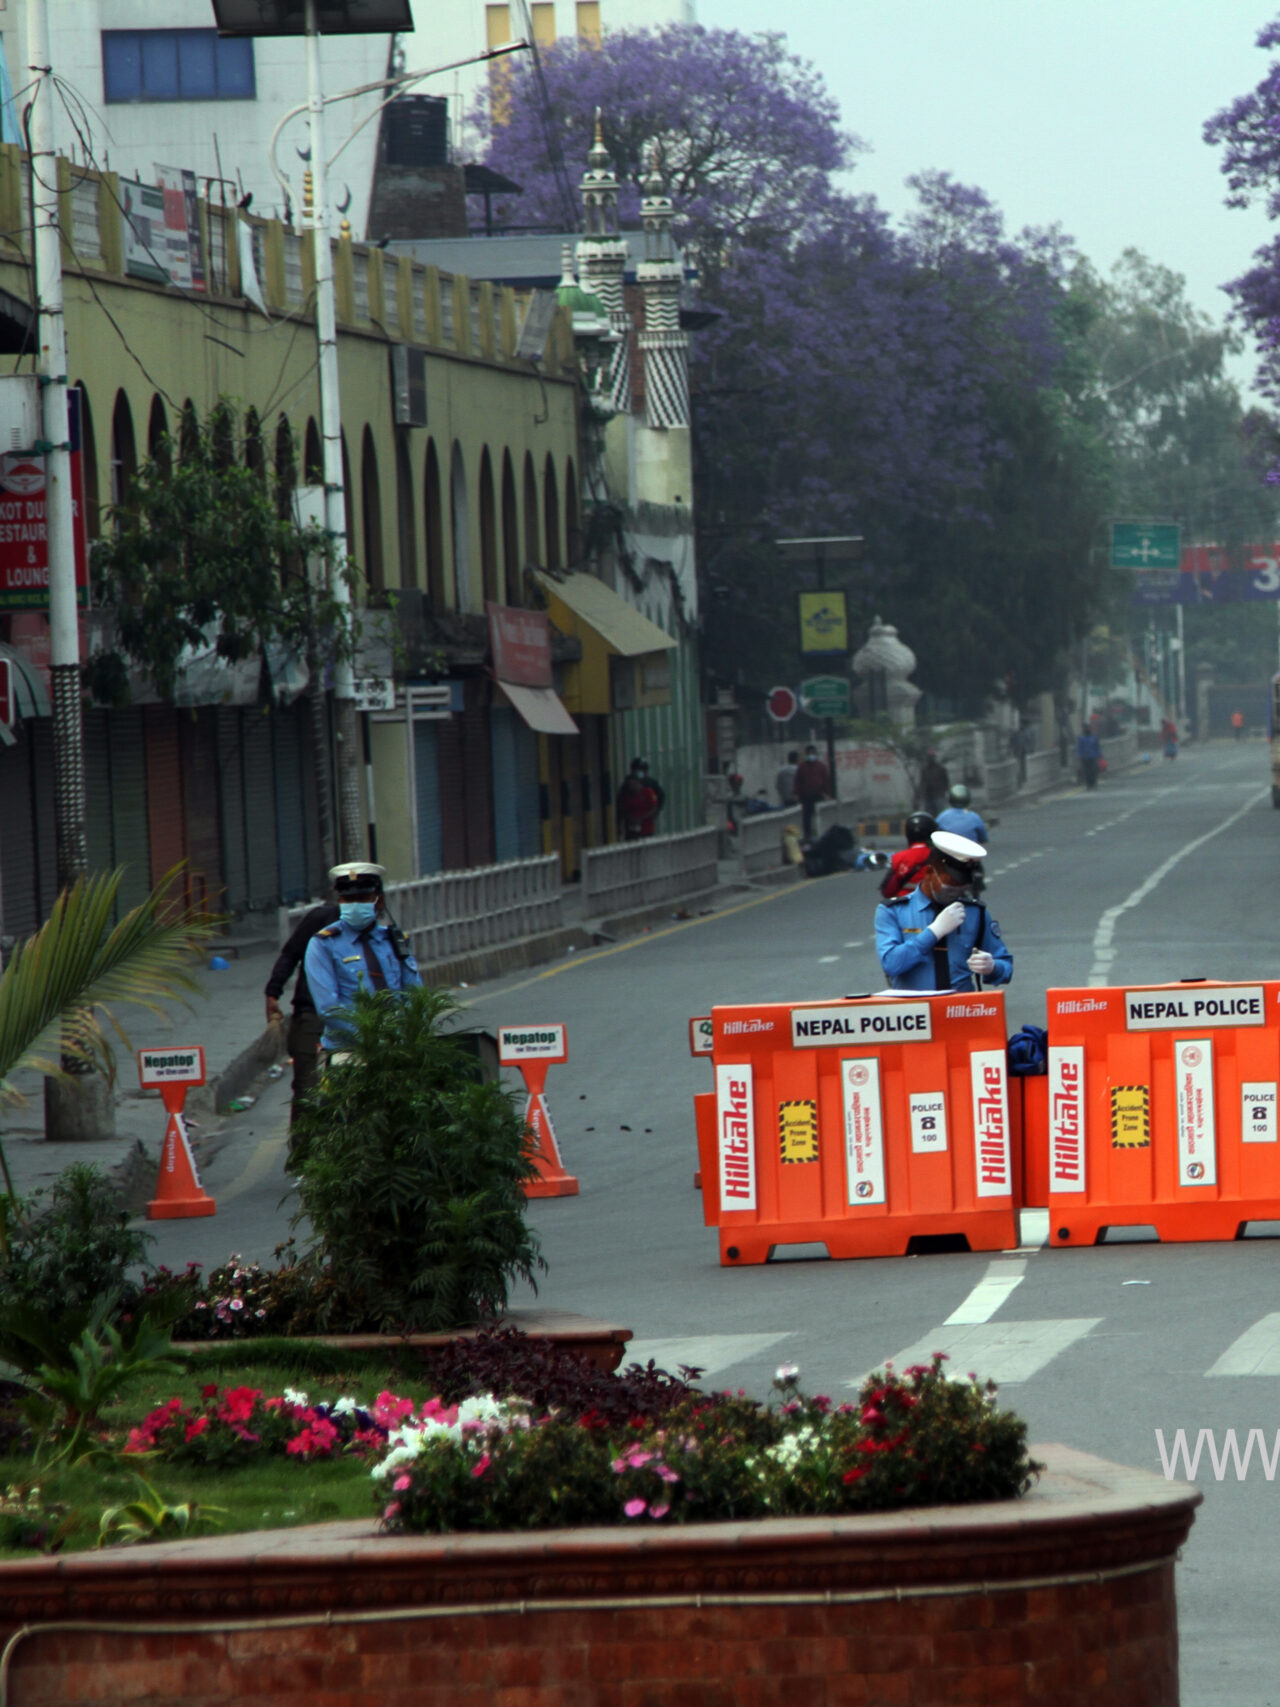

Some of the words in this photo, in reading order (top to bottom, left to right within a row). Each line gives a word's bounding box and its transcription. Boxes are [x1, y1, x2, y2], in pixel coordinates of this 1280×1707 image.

[27, 545, 37, 564] &
[6, 567, 50, 588] LOUNG
[946, 1003, 998, 1019] Hilltake
[1057, 998, 1108, 1014] Hilltake
[1130, 1002, 1189, 1019] NEPAL
[1194, 998, 1260, 1016] POLICE
[723, 1019, 775, 1035] Hilltake
[796, 1018, 855, 1037] NEPAL
[860, 1014, 927, 1033] POLICE
[503, 1031, 557, 1045] Nepatop
[144, 1055, 194, 1069] Nepatop
[1244, 1094, 1275, 1102] POLICE
[912, 1103, 943, 1112] POLICE
[785, 1119, 811, 1127] Accident
[979, 1066, 1006, 1184] Hilltake
[1054, 1062, 1079, 1181] Hilltake
[723, 1080, 750, 1199] Hilltake
[922, 1134, 937, 1142] 100
[165, 1130, 177, 1173] Nepatop
